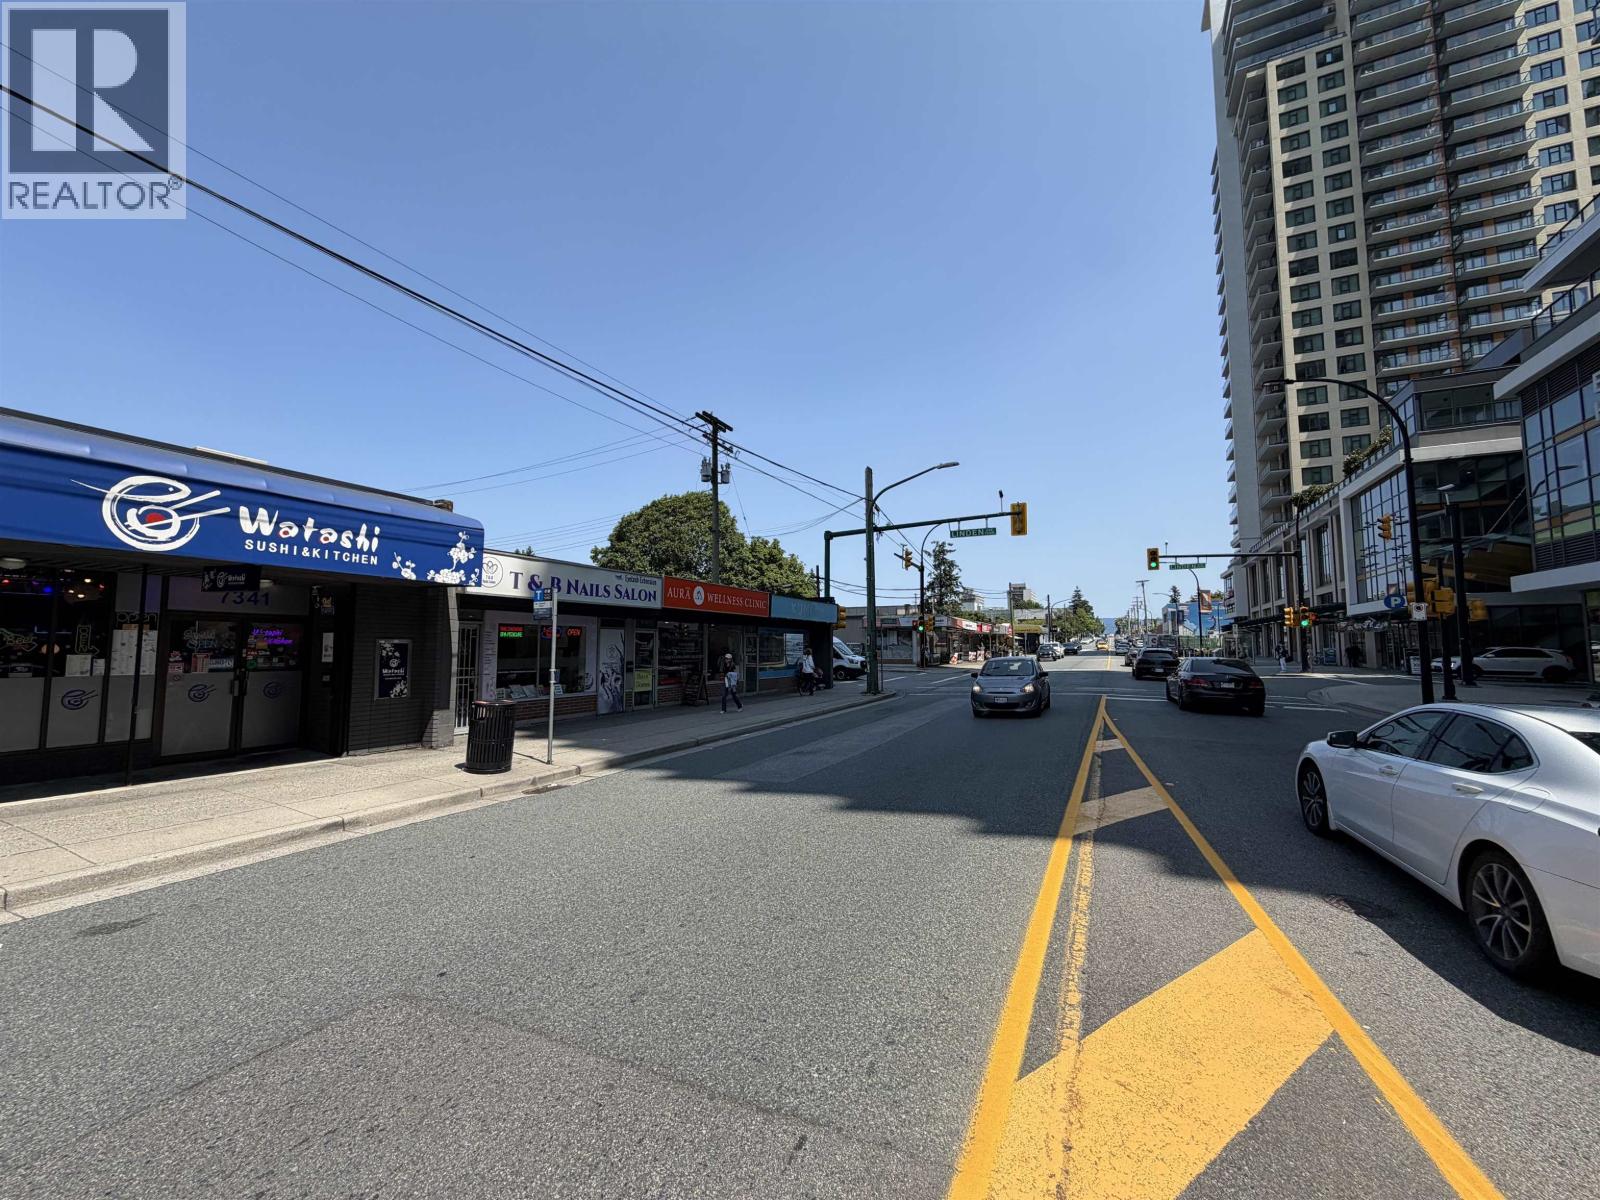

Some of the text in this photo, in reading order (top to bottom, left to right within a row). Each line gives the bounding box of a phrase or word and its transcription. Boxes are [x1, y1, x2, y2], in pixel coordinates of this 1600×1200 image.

[239, 505, 380, 553] Watashi
[951, 528, 984, 538] LINDEN
[244, 539, 378, 565] SUSHI&KITCHEN
[510, 571, 523, 589] T
[528, 574, 543, 591] &
[551, 576, 561, 592] B
[707, 592, 744, 607] WELLNESS
[744, 598, 767, 609] CLINIC
[1390, 596, 1401, 608] P
